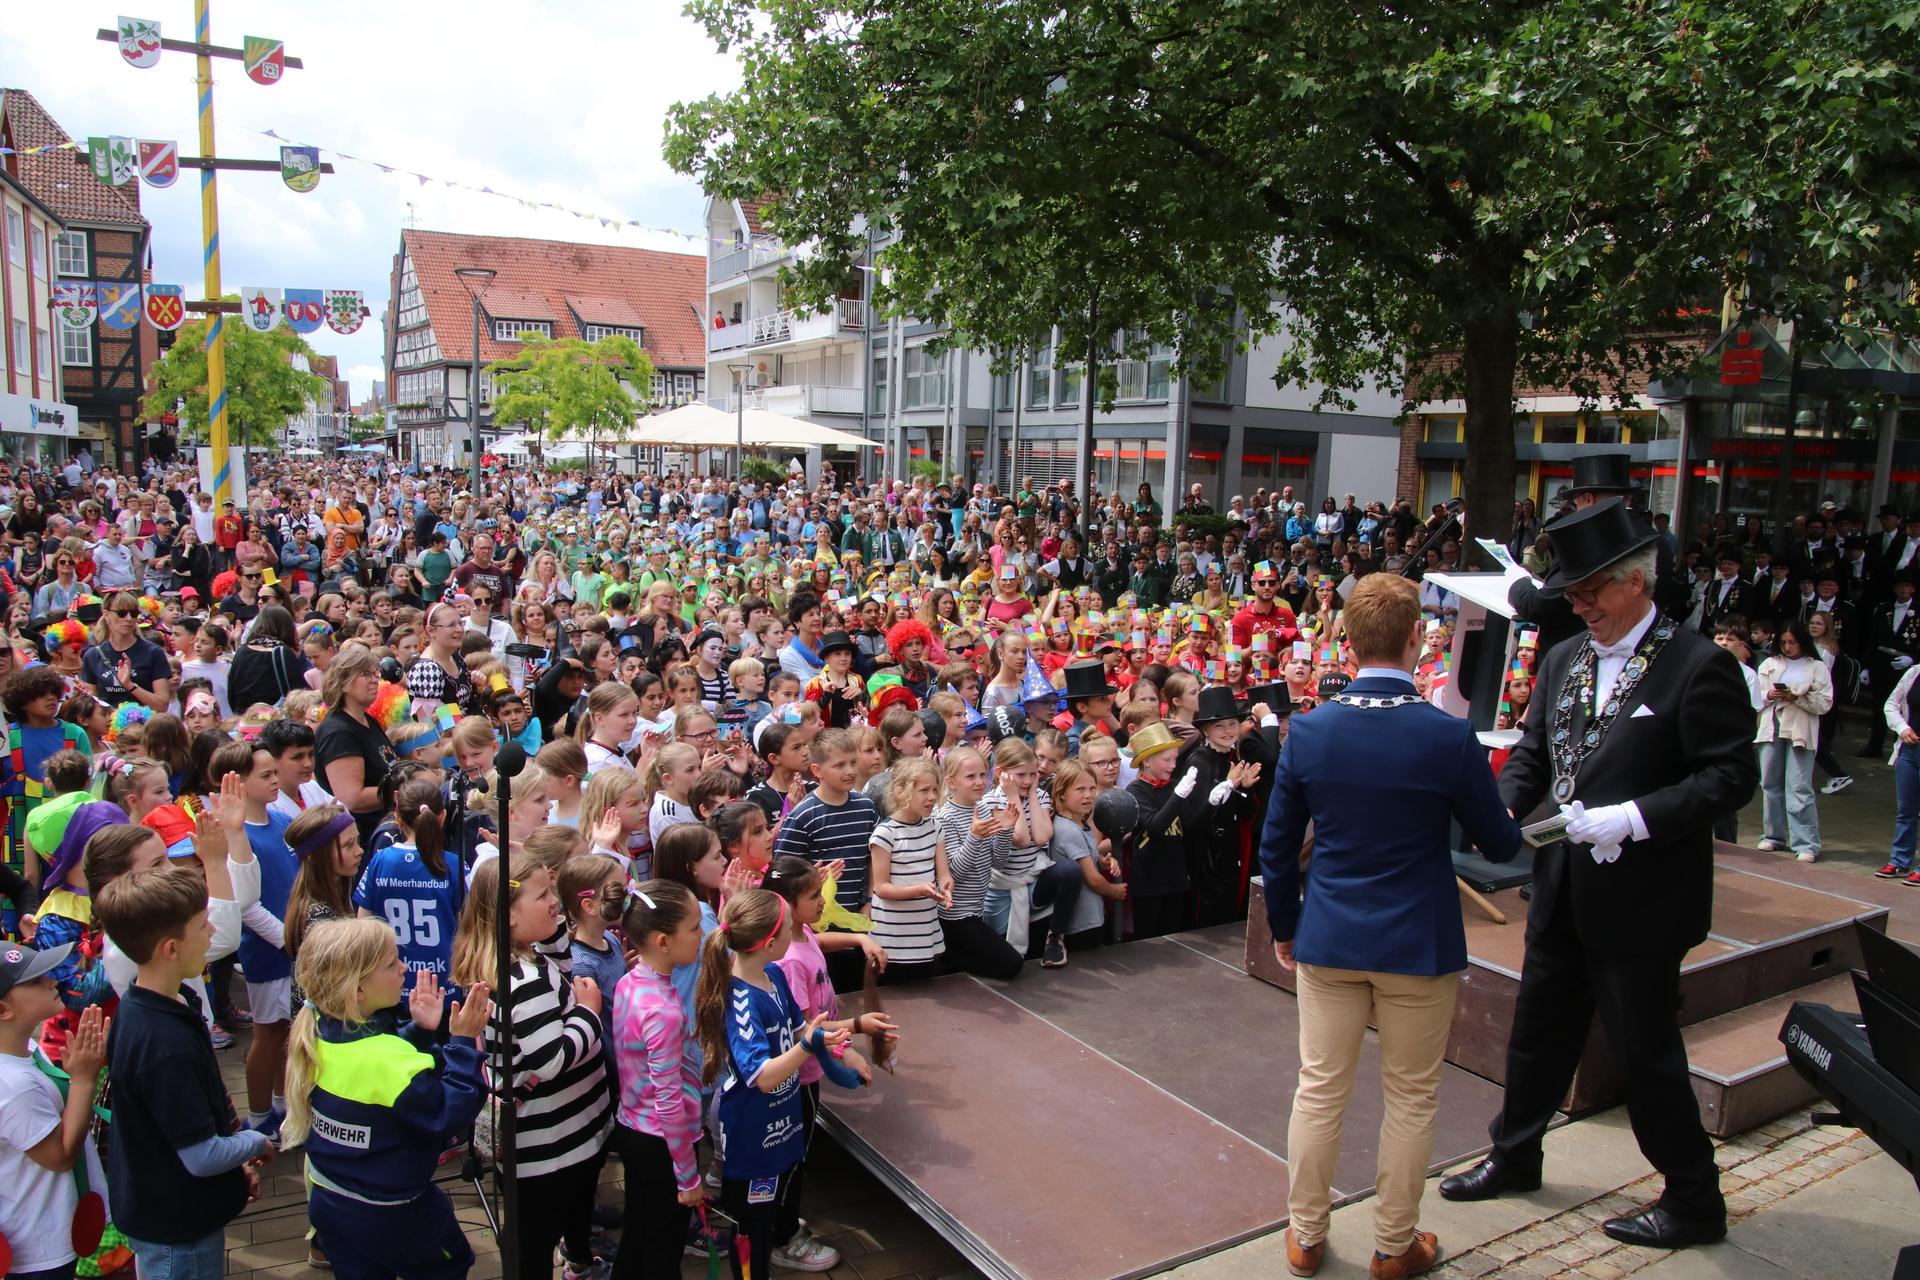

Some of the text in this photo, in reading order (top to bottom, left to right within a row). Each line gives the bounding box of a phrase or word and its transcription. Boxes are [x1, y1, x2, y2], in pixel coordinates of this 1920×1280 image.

[1711, 440, 1838, 458] Stadtsparasse
[384, 898, 441, 947] 85
[404, 956, 447, 973] kmak
[1797, 1030, 1832, 1071] YAMAHA
[311, 1111, 366, 1143] EUERWEHR
[767, 1115, 791, 1132] SMT
